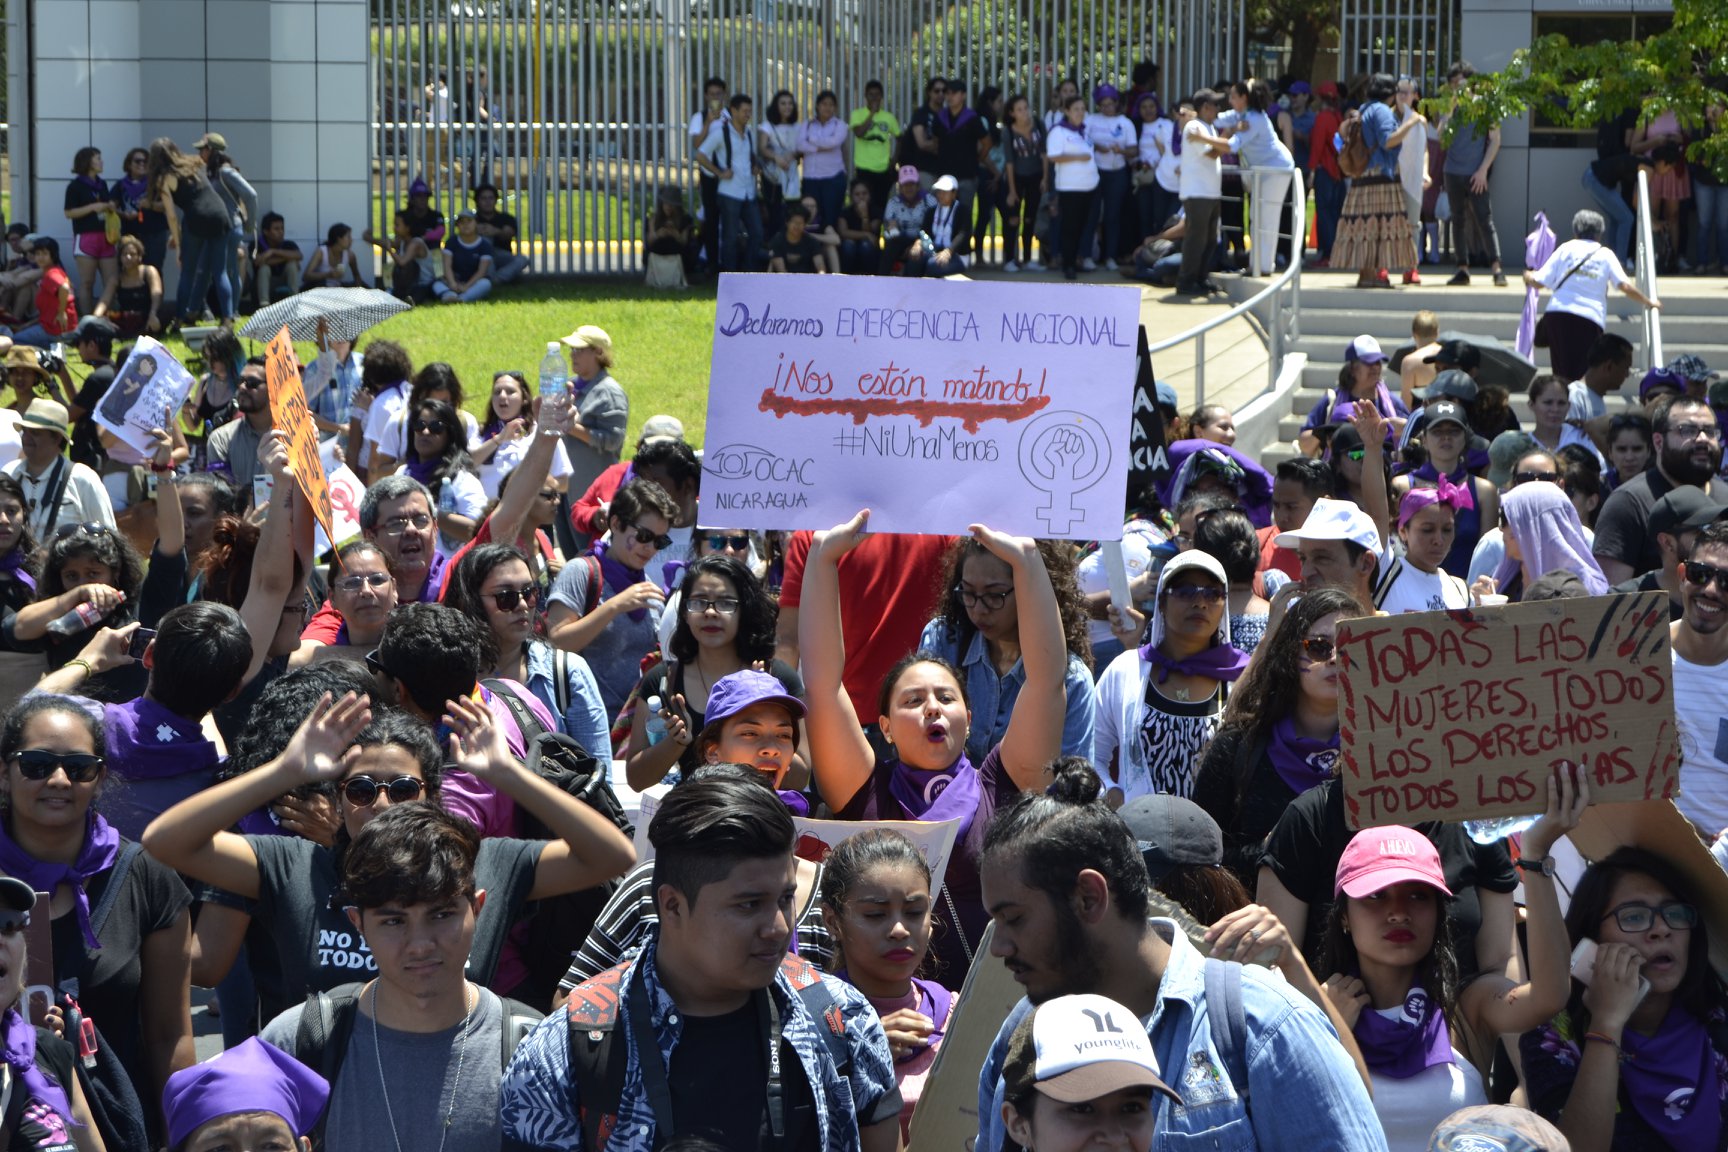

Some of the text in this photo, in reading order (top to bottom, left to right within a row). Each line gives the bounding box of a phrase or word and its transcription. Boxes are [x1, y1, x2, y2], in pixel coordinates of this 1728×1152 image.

[719, 302, 1131, 348] Declaramos EMERGENCIA NACIONAL
[857, 360, 928, 398] están
[833, 424, 999, 462] #NiUnaMenos
[754, 457, 815, 486] OCAC
[715, 491, 808, 510] NICARAGUA
[1351, 617, 1588, 688] TODAS LAS
[1363, 666, 1666, 739] MUJERES, TODOS
[1367, 738, 1432, 782] LOS
[1358, 779, 1459, 820] TODOS
[1477, 770, 1537, 806] LOS
[319, 929, 352, 949] NO
[768, 1038, 780, 1074] SONY
